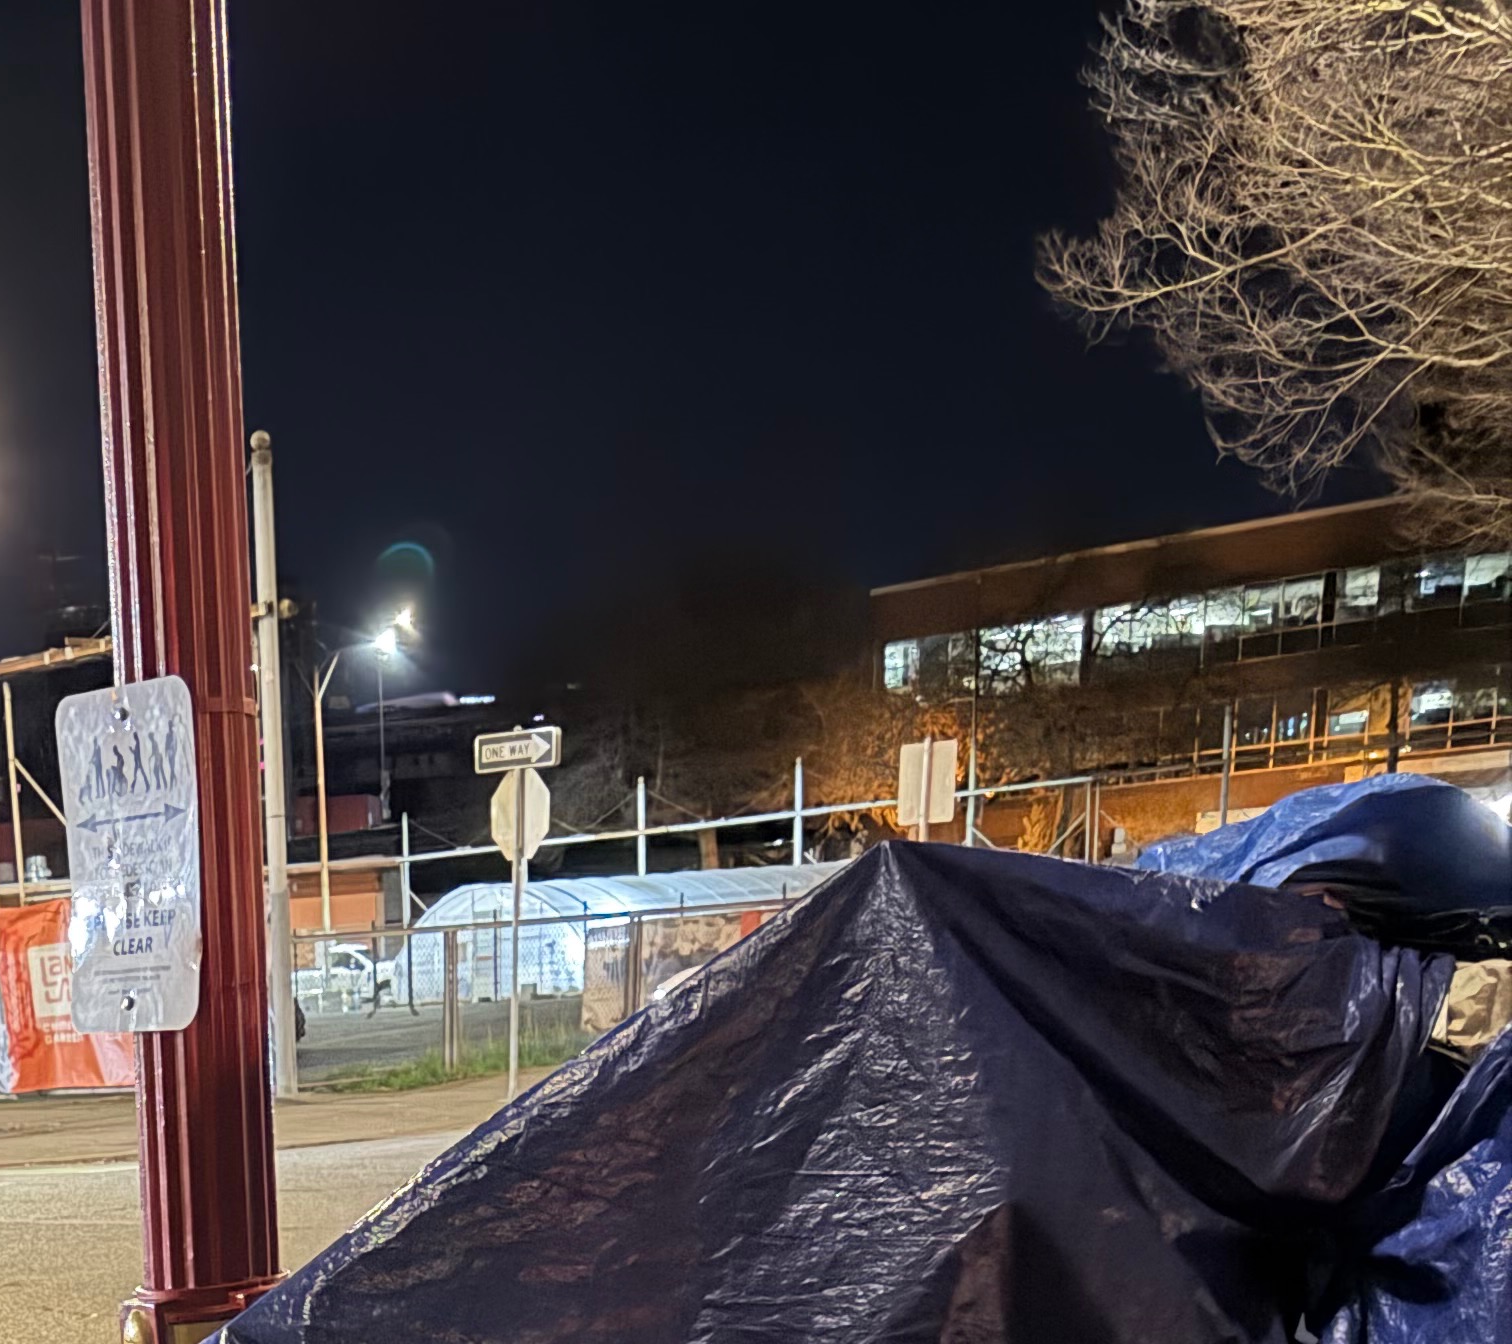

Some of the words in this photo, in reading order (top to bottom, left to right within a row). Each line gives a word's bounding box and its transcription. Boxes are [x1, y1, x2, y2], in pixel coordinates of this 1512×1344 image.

[484, 746, 505, 760] ONE
[509, 743, 530, 756] WAY
[143, 909, 176, 928] KEEP
[113, 936, 153, 957] CLEAR
